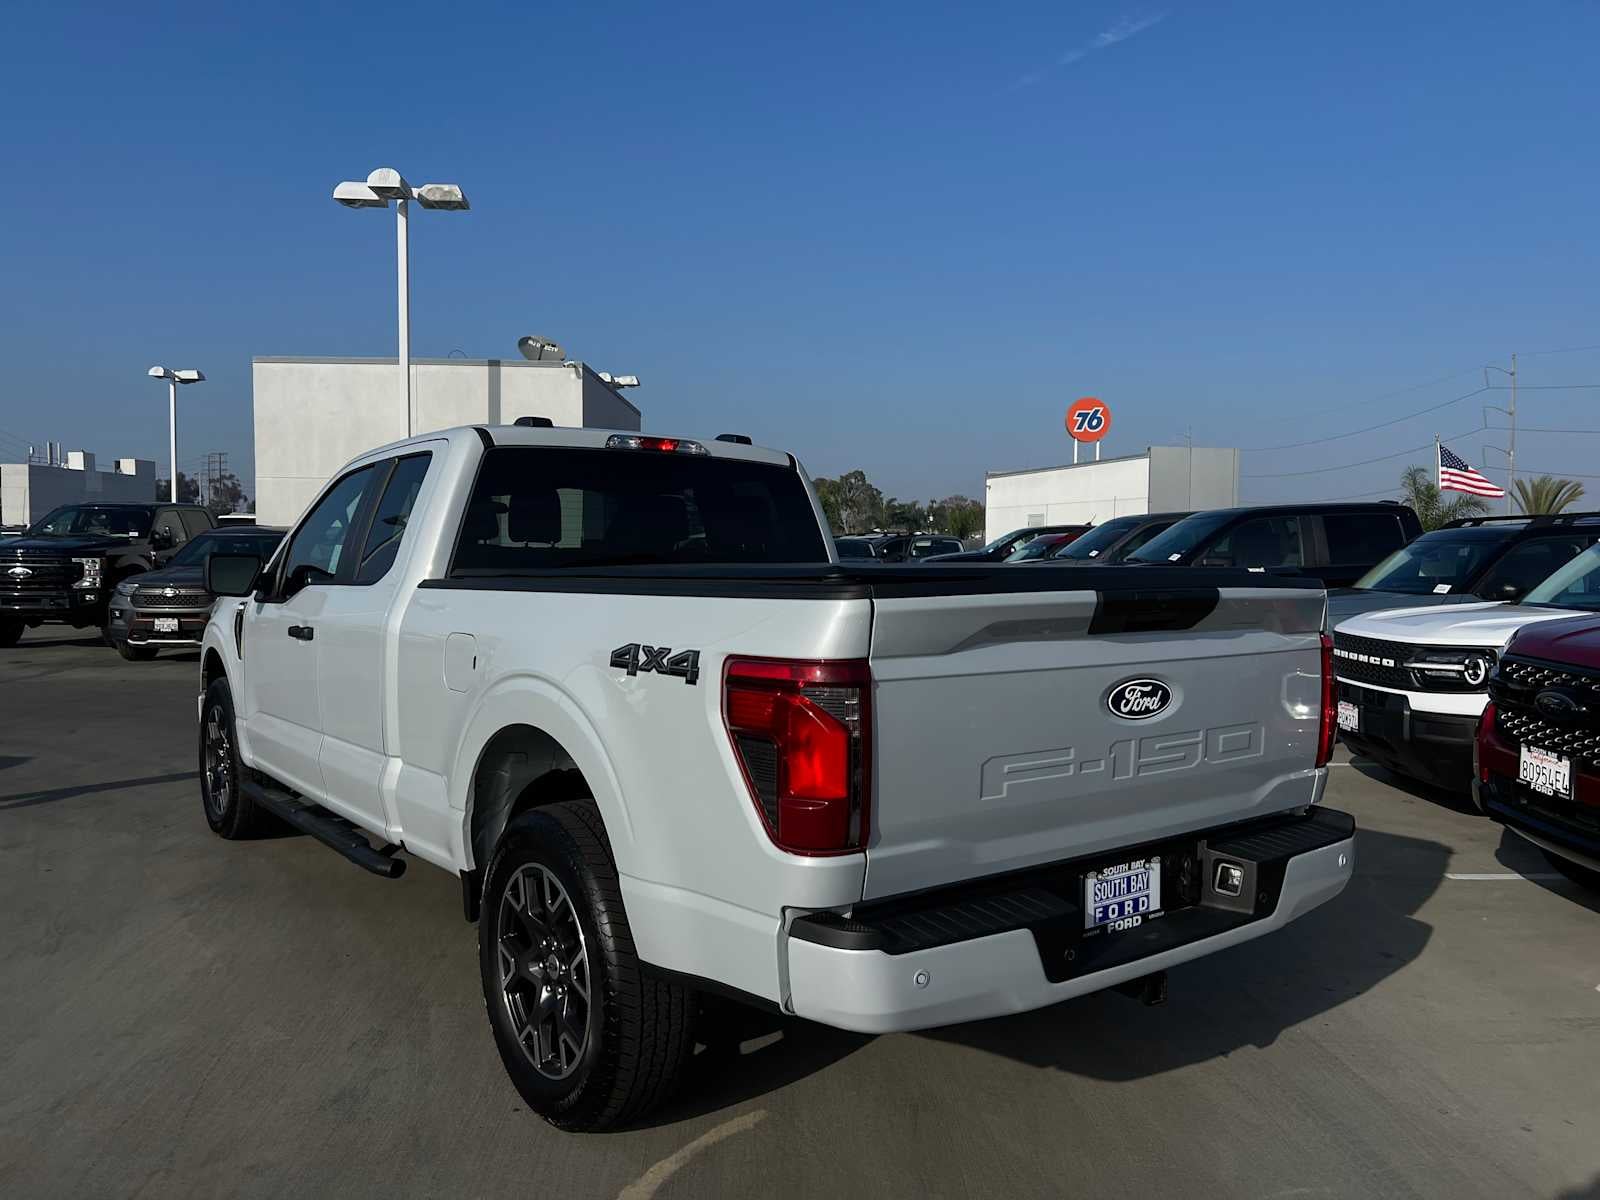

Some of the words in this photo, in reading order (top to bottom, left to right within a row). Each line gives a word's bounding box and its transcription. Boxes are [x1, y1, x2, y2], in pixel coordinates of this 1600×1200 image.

[1073, 407, 1105, 432] 76
[1333, 648, 1395, 667] BRONCO
[1120, 685, 1163, 713] Ford
[980, 721, 1265, 800] F-150
[1523, 760, 1568, 792] 80954E4
[1530, 782, 1554, 796] FORD
[1103, 863, 1129, 876] SOUTH
[1131, 859, 1145, 869] BAY
[1095, 877, 1127, 901] SOUTH
[1131, 872, 1148, 892] BAY
[1107, 915, 1142, 934] FORD
